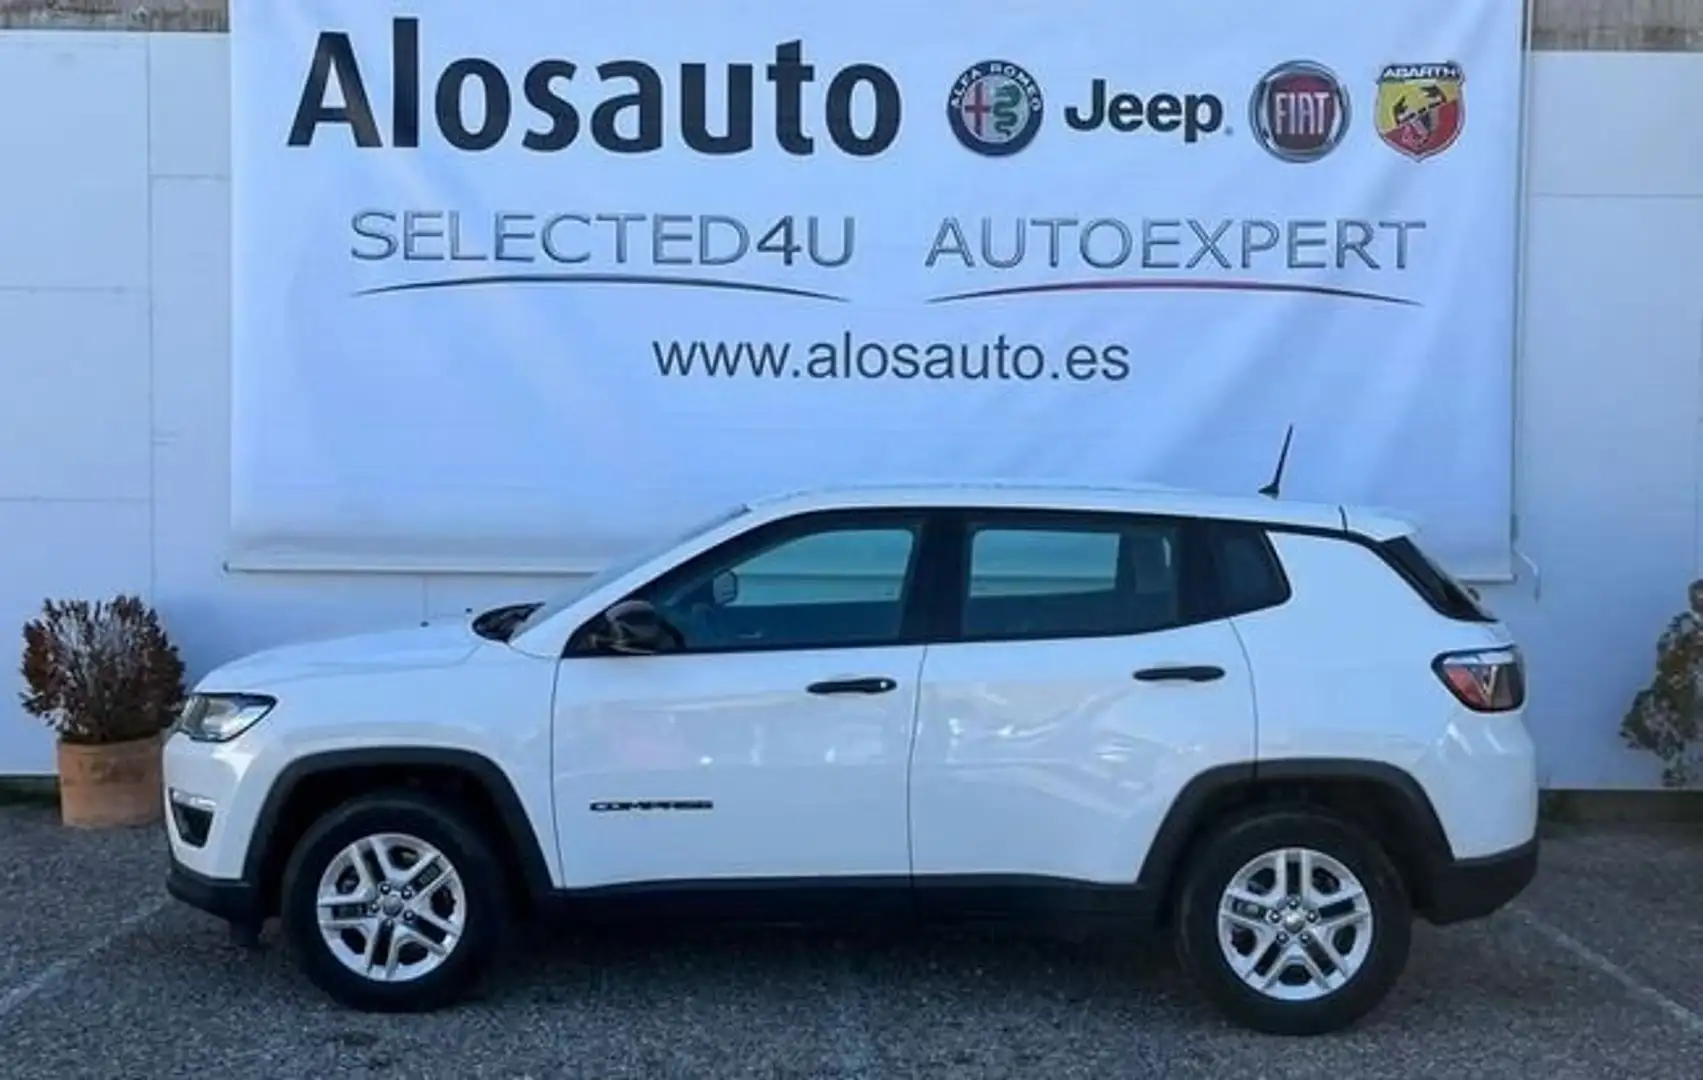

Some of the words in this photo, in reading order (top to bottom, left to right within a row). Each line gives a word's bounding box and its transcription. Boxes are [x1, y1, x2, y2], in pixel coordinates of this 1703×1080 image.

[287, 17, 902, 156] Alosauto
[989, 63, 1042, 112] ROMEO
[1383, 67, 1456, 78] ABARTH
[1065, 79, 1224, 142] Jeep
[1274, 92, 1330, 135] FIAT
[350, 211, 855, 267] SELECTED4U
[925, 217, 1426, 270] AUTOEXPERT
[653, 332, 1130, 380] www.alosauto.es
